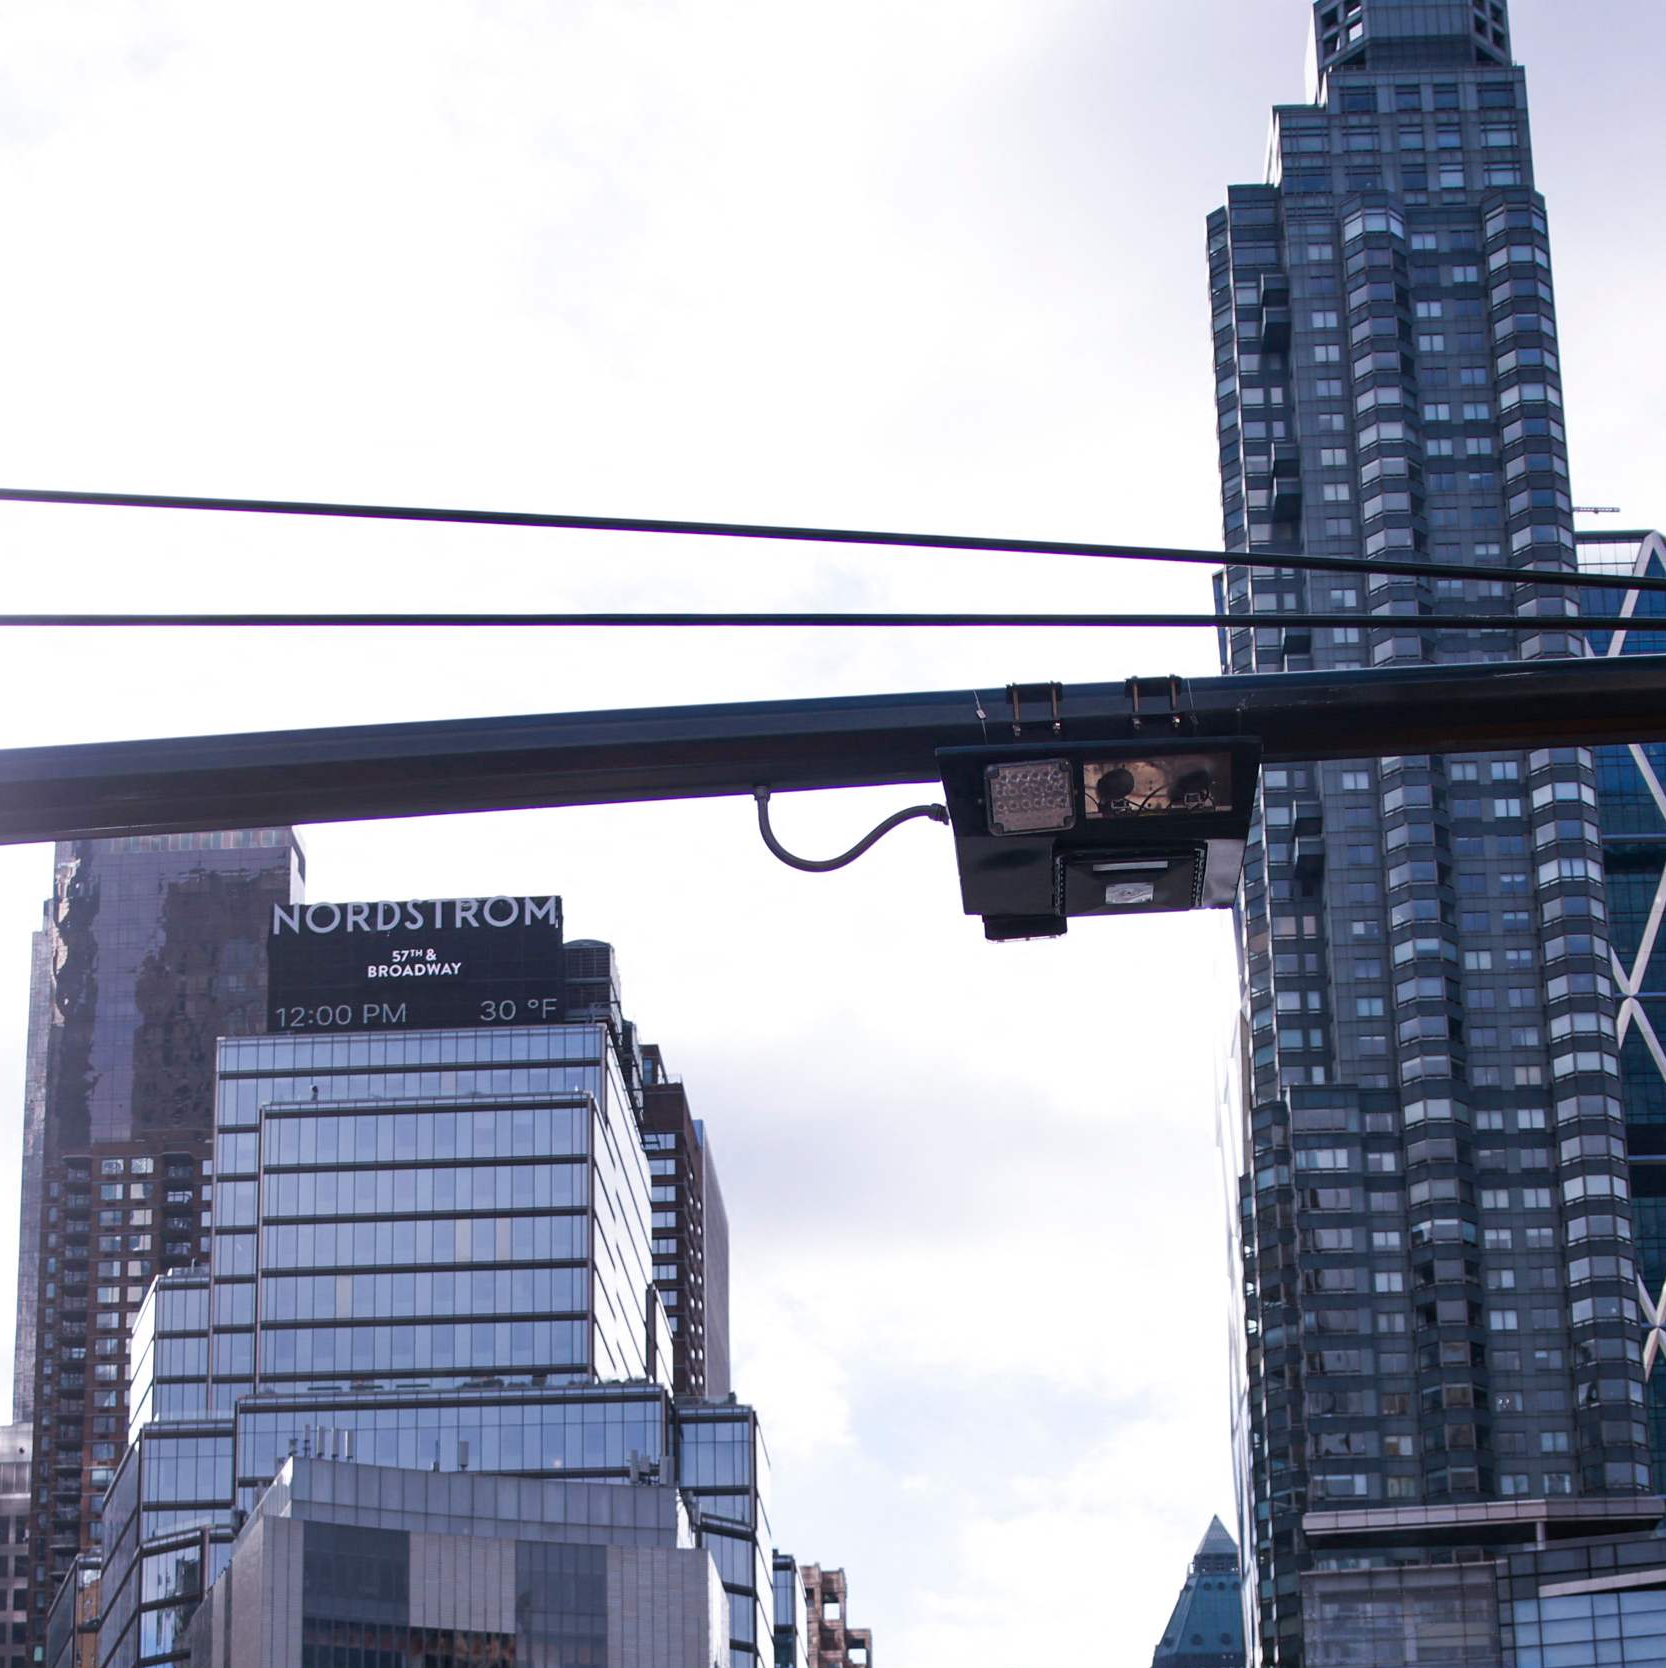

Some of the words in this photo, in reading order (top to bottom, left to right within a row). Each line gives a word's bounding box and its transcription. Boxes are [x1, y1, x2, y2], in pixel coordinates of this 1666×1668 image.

[273, 896, 558, 935] NORDSTROM
[391, 948, 423, 962] 57TH
[425, 948, 438, 961] &
[367, 961, 462, 979] BROADWAY
[276, 1004, 353, 1027] 12:00
[363, 1003, 407, 1025] PM
[480, 1000, 517, 1021] 30
[527, 998, 558, 1020] °F
